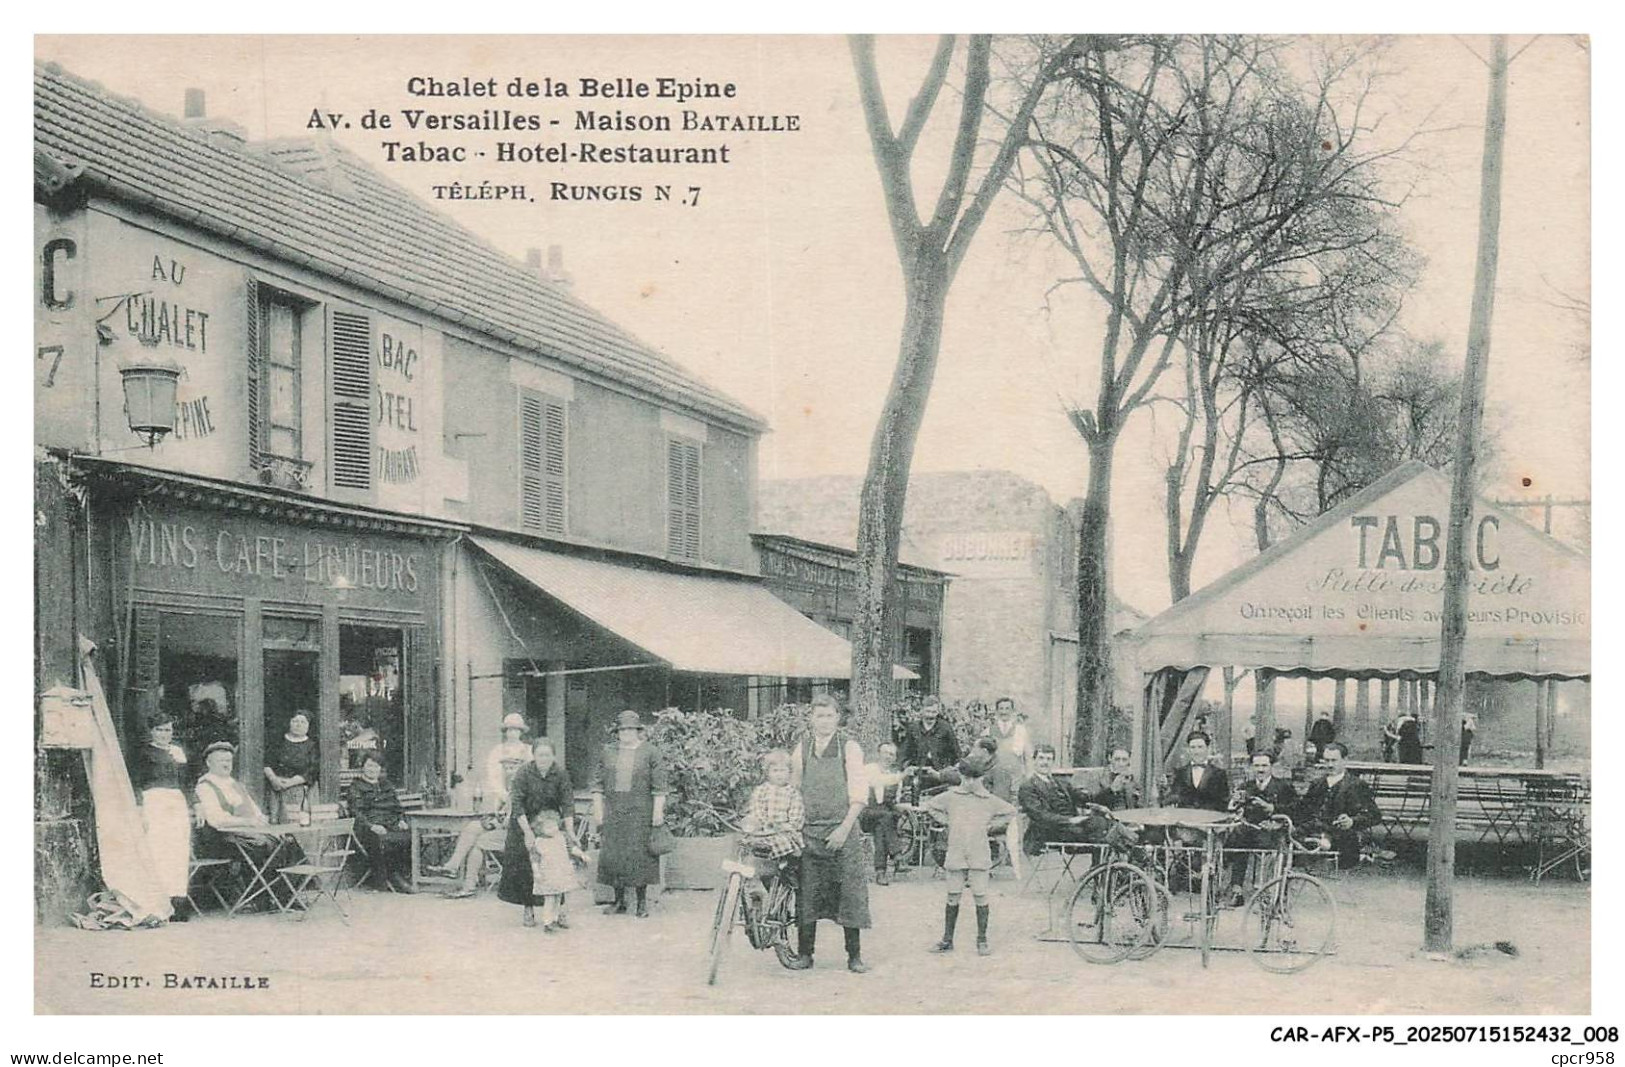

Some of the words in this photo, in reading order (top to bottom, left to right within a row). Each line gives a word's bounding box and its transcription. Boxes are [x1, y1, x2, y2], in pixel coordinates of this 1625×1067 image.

[152, 255, 186, 285] AU
[38, 345, 64, 388] 7
[377, 333, 418, 383] BAC
[127, 516, 198, 568] VINS
[1351, 514, 1499, 571] TABC
[1323, 604, 1345, 620] les
[1357, 603, 1414, 621] Clients
[1467, 610, 1502, 623] eurs
